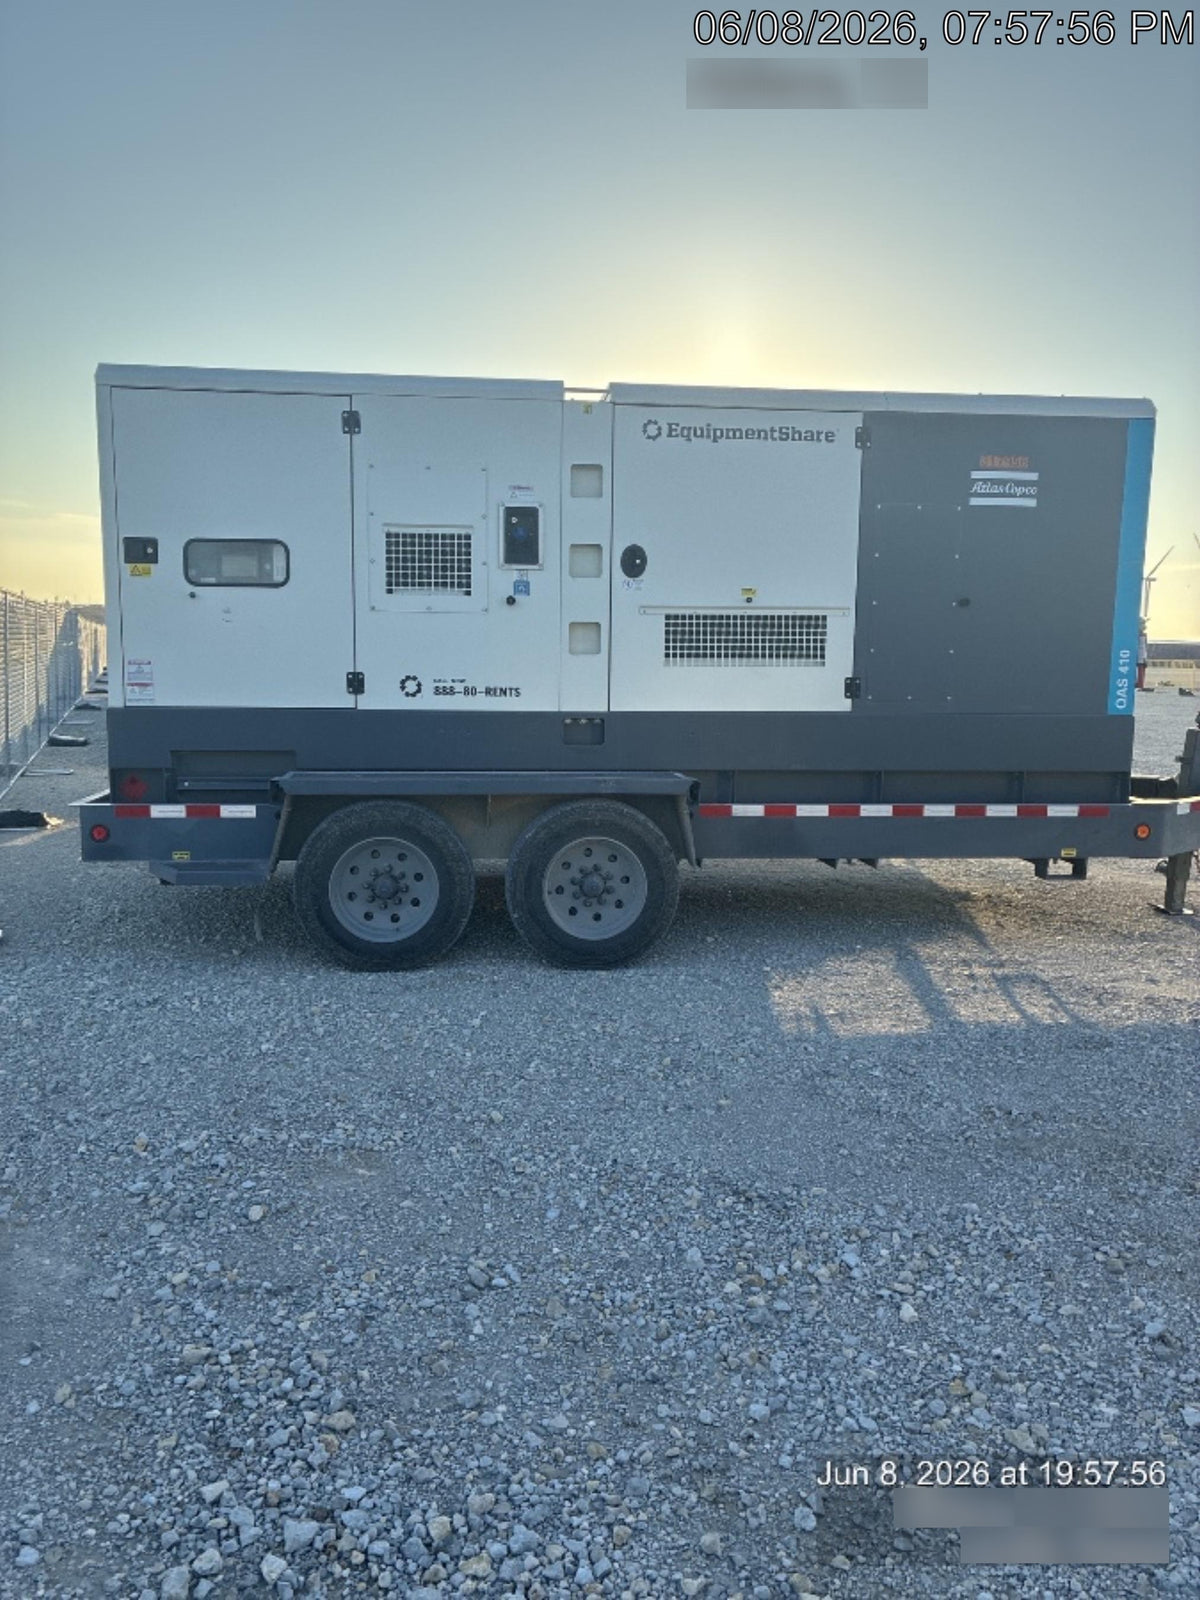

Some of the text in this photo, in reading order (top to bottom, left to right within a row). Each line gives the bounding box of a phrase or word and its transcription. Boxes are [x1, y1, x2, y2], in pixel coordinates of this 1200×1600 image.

[666, 422, 837, 444] EquipmentShare
[969, 481, 1004, 494] Atlas
[1118, 649, 1130, 674] 410
